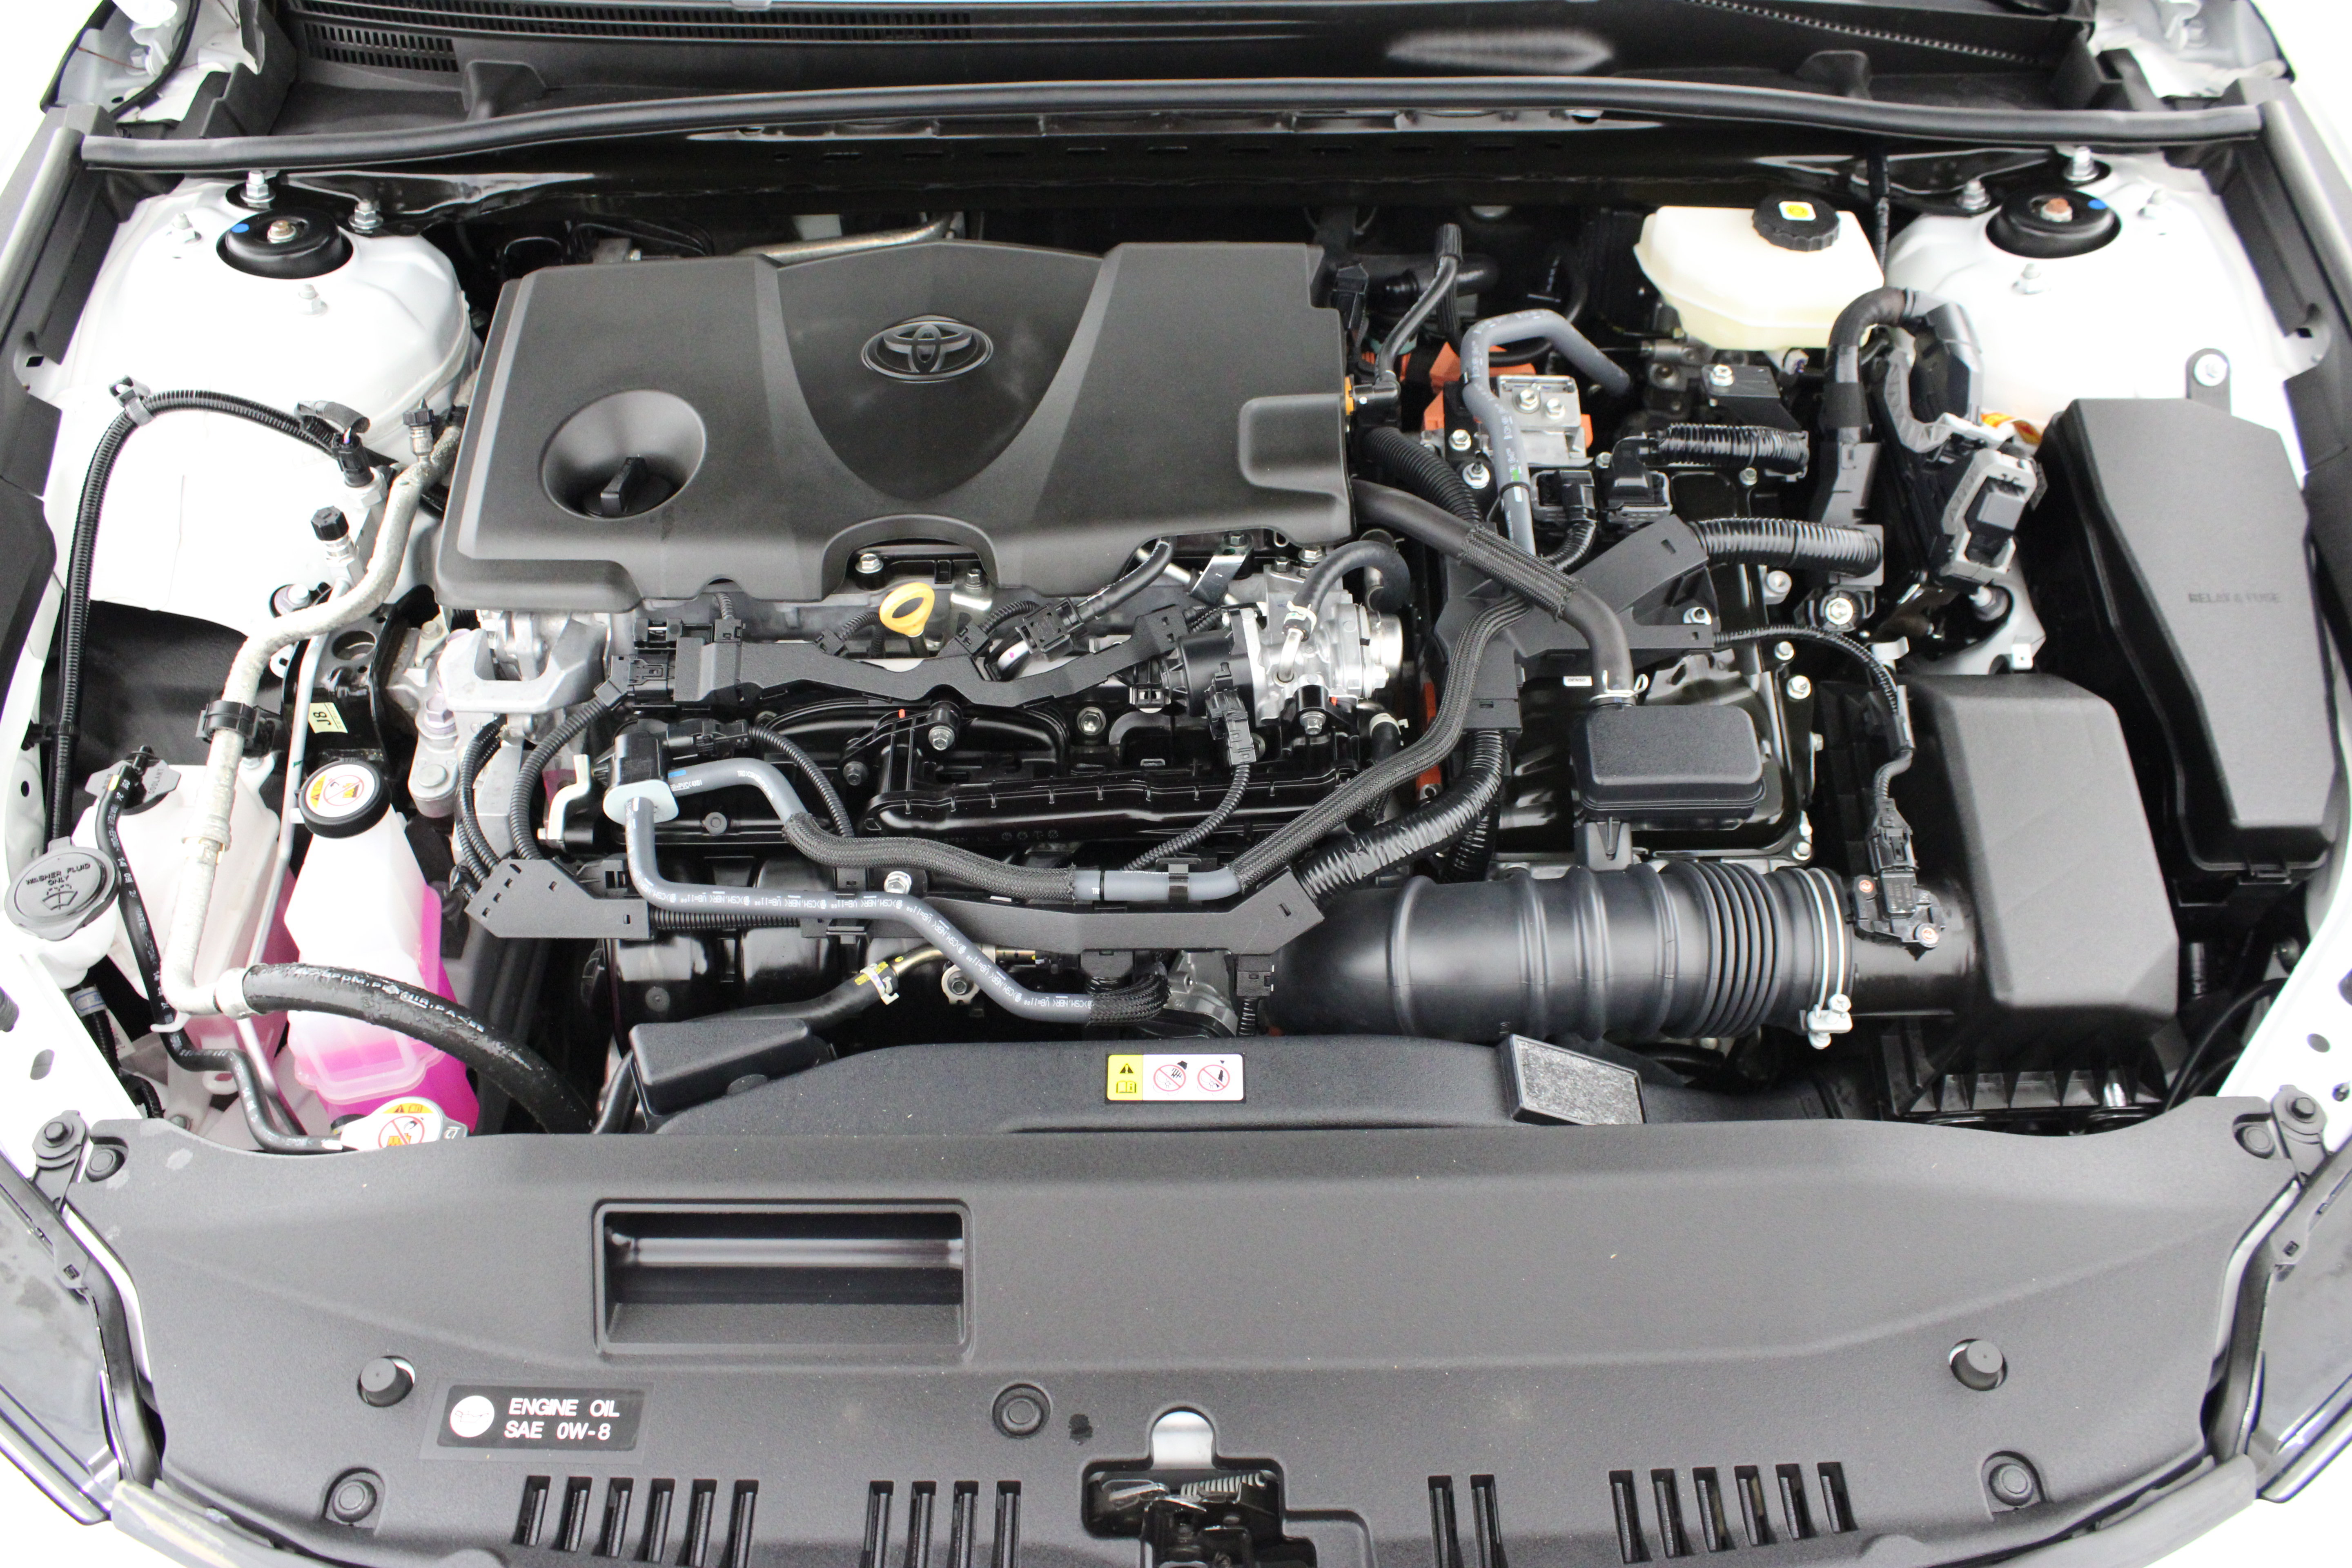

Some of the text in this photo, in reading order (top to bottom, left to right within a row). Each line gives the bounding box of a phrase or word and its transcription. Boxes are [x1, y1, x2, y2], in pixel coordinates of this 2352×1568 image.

[26, 863, 91, 885] WASHER FLUID
[48, 875, 69, 885] ONLY
[508, 1397, 620, 1418] ENGINE OIL
[504, 1420, 611, 1441] SAE 0W-8
